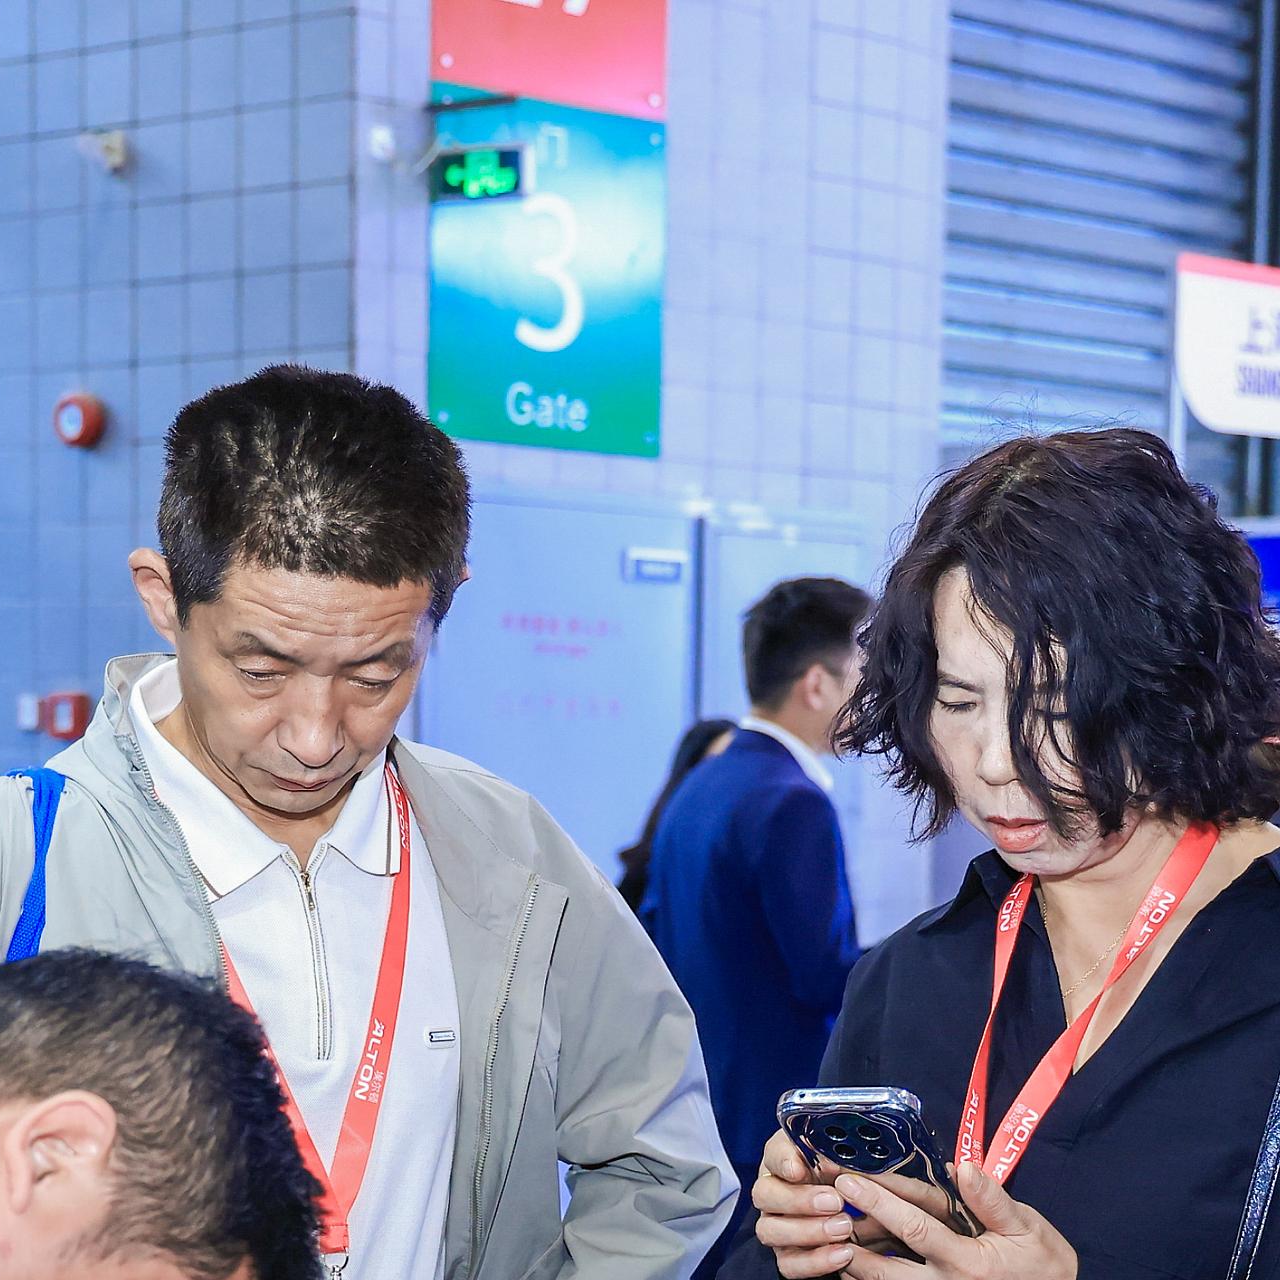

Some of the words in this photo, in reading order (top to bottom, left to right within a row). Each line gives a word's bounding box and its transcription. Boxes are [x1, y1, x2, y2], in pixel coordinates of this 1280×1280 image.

[513, 193, 585, 353] 3
[506, 383, 588, 432] Gate
[1126, 891, 1175, 961] ALTON
[354, 1018, 386, 1101] ALTON
[992, 1108, 1039, 1179] ALTON
